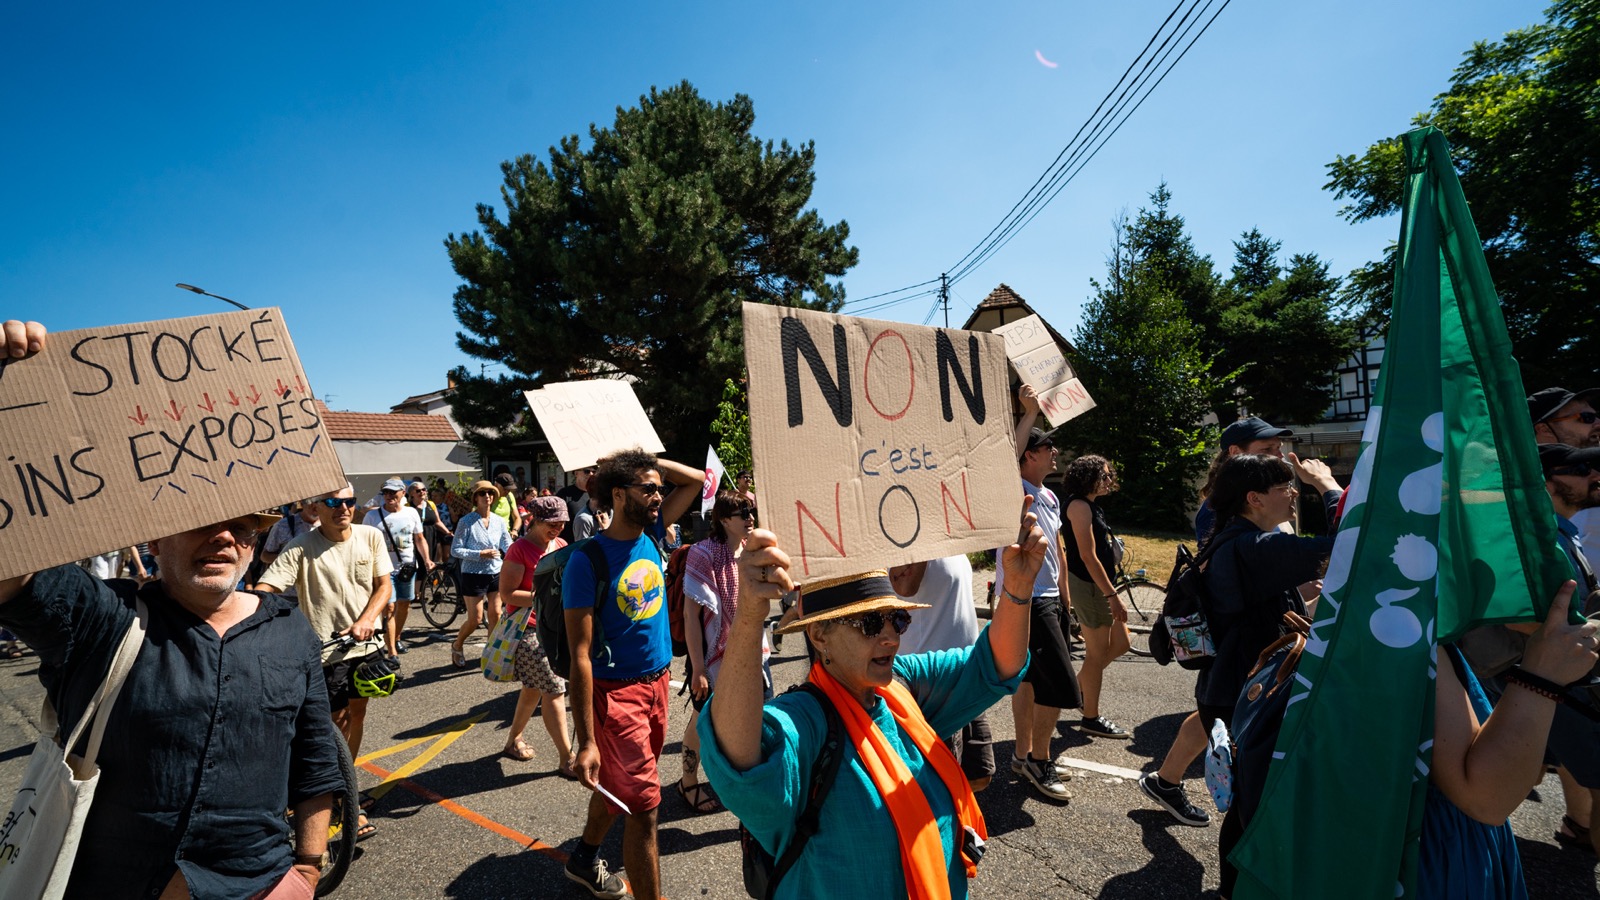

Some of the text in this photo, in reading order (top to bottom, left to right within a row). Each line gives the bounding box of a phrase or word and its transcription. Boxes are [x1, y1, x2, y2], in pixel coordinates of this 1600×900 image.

[71, 311, 283, 396] STOCKÉ
[780, 316, 986, 428] NON
[128, 389, 321, 482] EXPOSÉS
[1040, 383, 1087, 418] NON
[860, 440, 938, 476] c'est
[795, 471, 976, 576] NON
